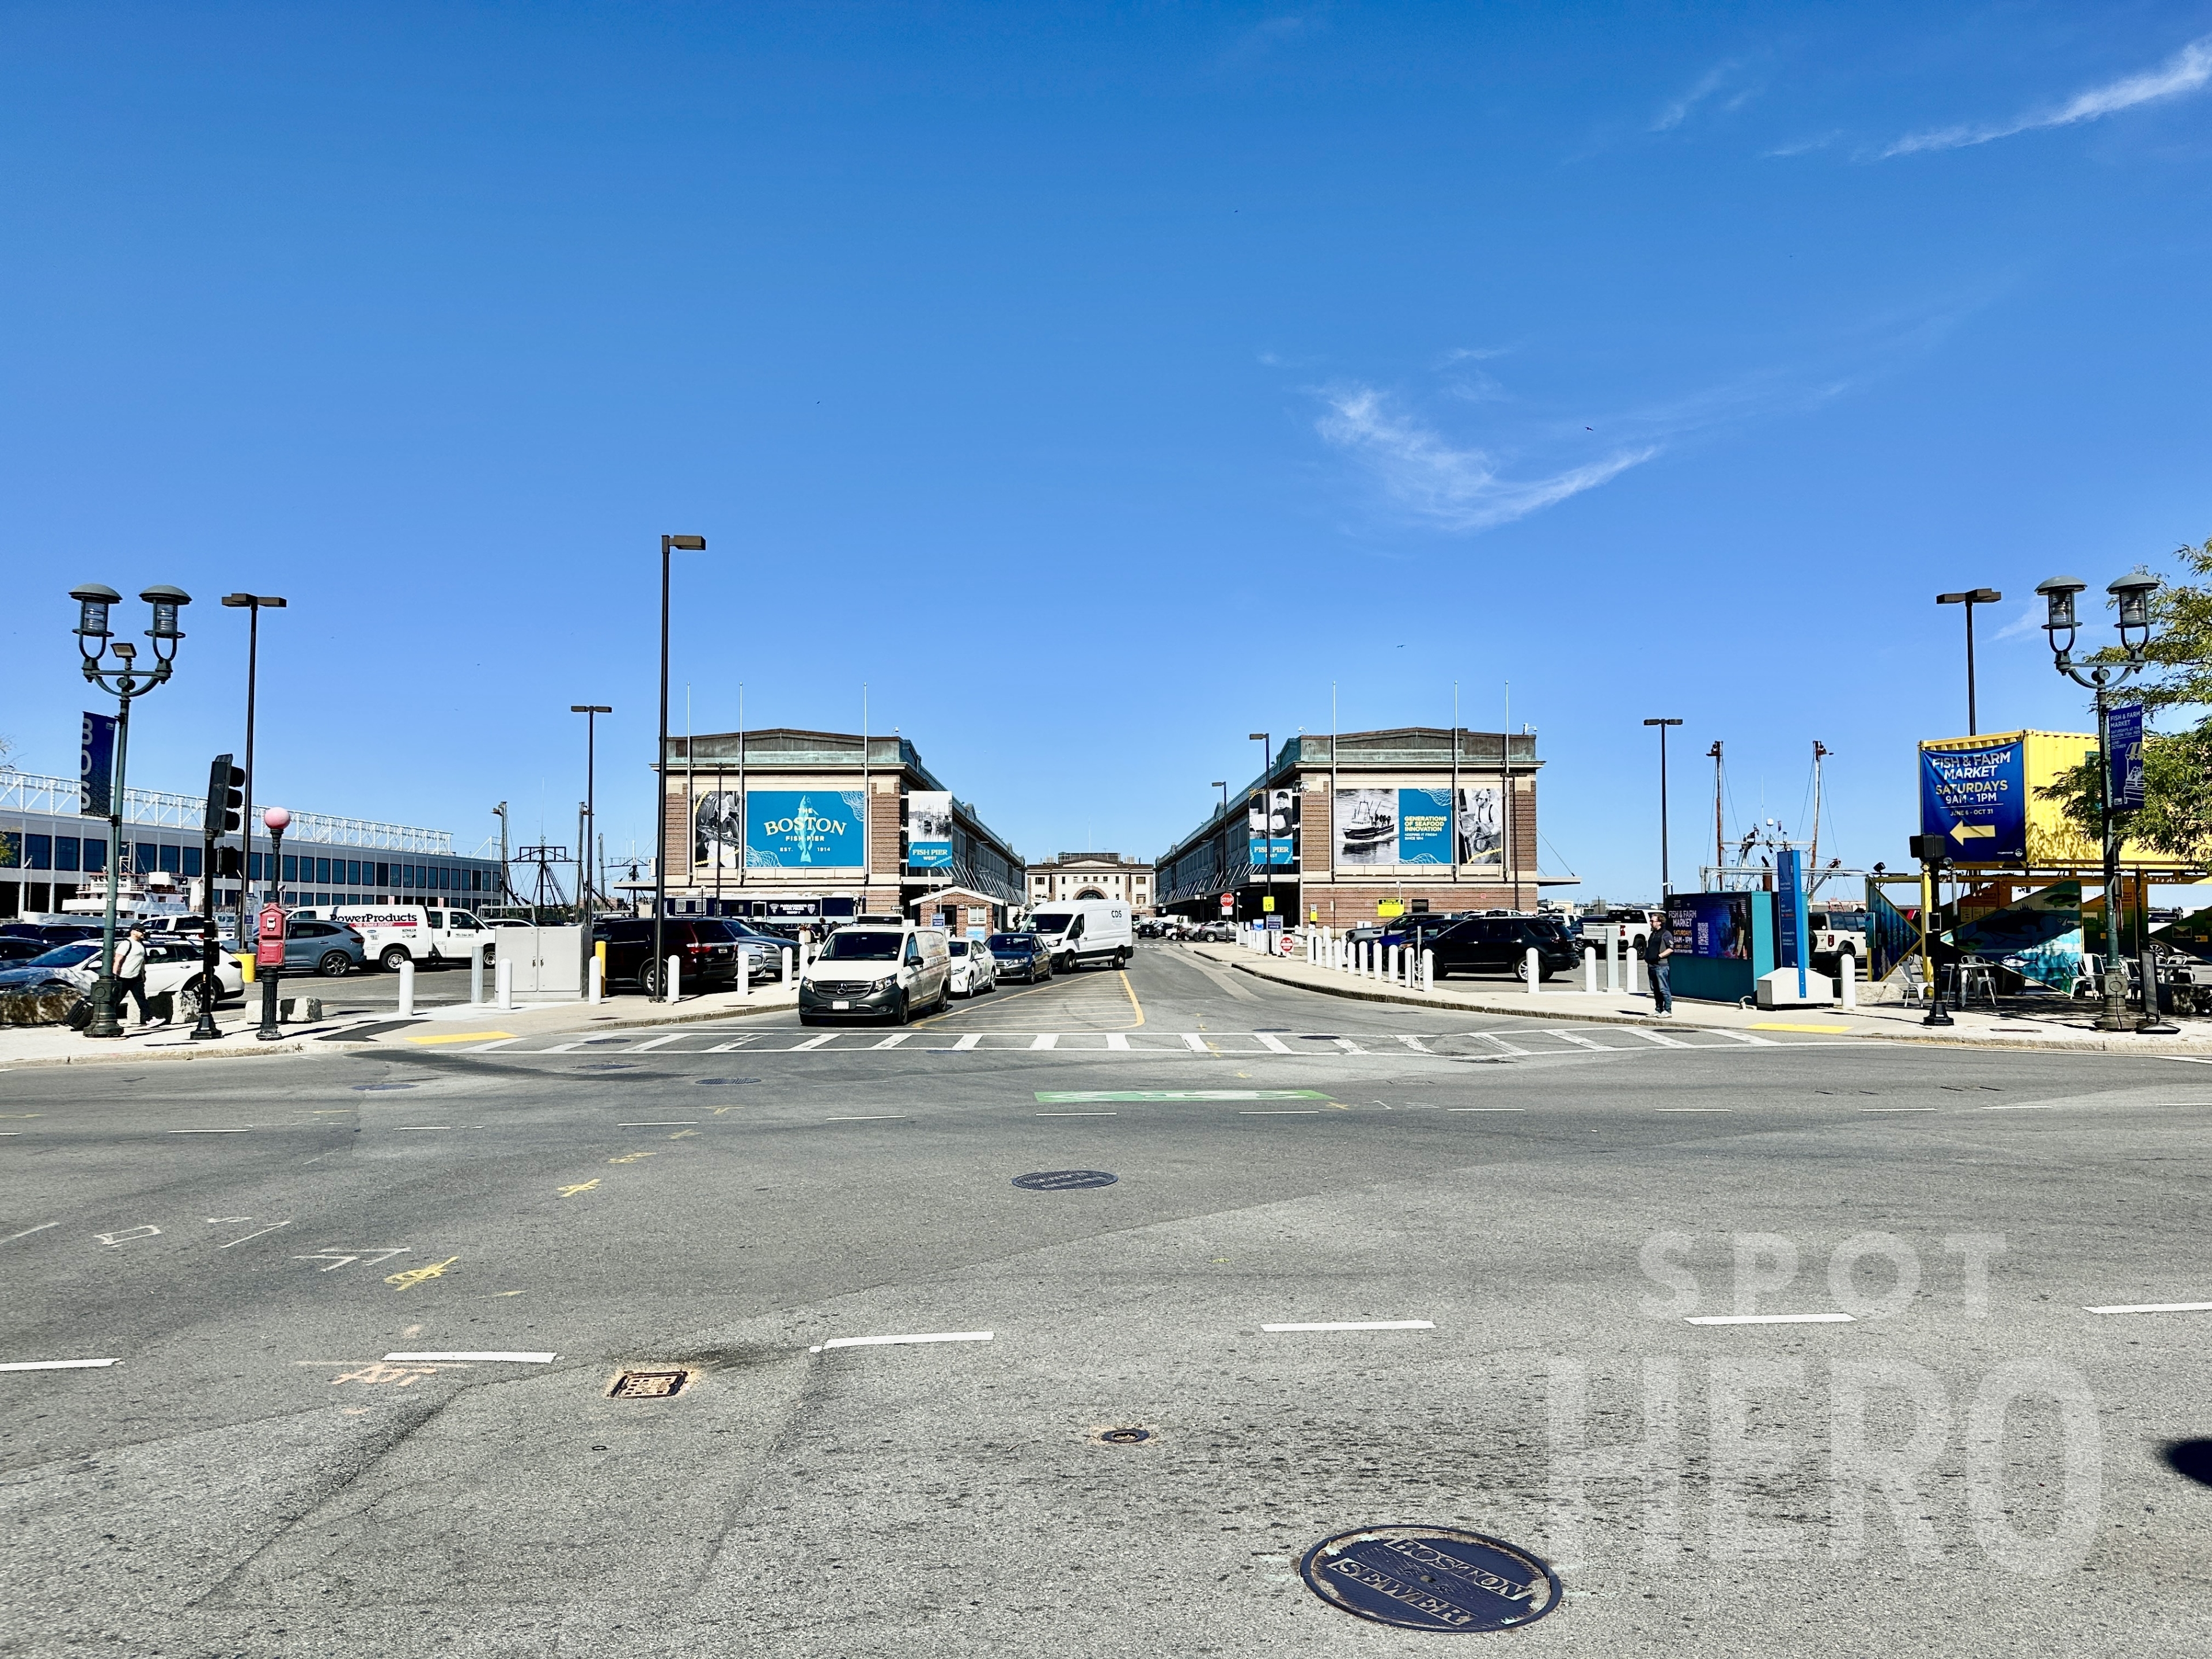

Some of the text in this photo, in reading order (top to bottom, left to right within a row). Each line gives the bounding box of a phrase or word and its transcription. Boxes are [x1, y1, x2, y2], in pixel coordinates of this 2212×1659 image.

[2111, 719, 2131, 728] MARKET
[1931, 751, 2011, 768] FISH & FARM
[1944, 765, 1998, 780] MARKET
[1936, 779, 2008, 795] SATURDAYS
[1945, 794, 1967, 804] 9AM
[1976, 792, 1997, 802] 1PM
[764, 816, 847, 836] BOSTON
[329, 914, 417, 922] PowerProducts
[1111, 910, 1122, 918] CDS
[1683, 910, 1696, 918] FARM
[1673, 918, 1692, 927] MARKET
[1387, 1539, 1528, 1600] BOSTON
[1333, 1560, 1473, 1625] SEWER
